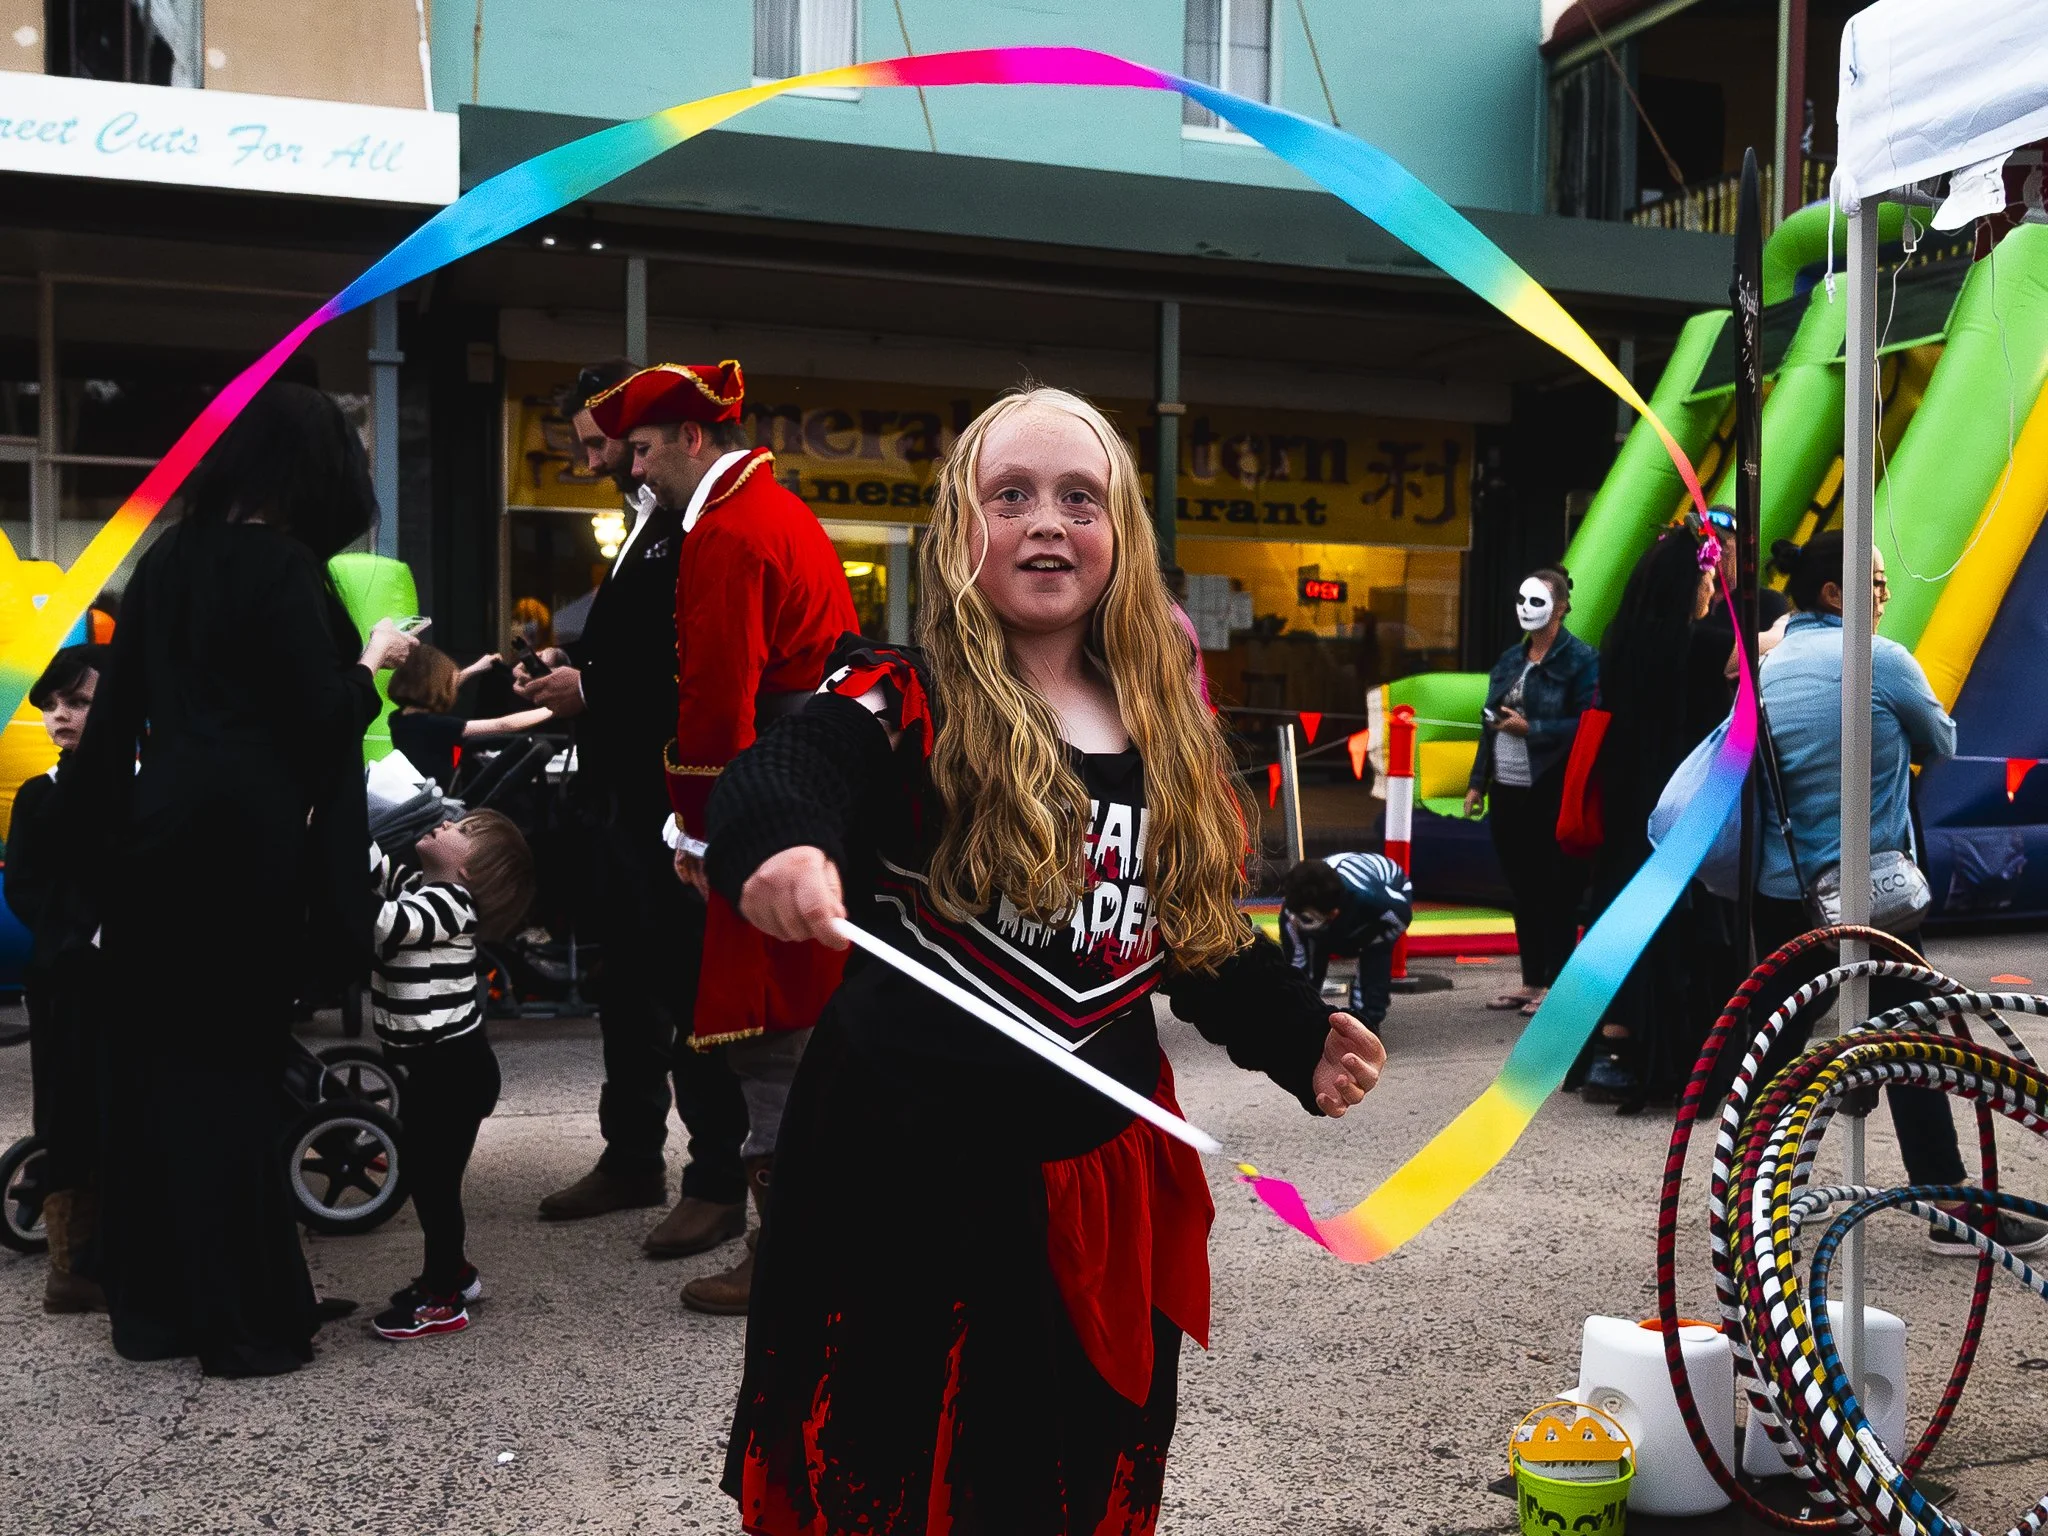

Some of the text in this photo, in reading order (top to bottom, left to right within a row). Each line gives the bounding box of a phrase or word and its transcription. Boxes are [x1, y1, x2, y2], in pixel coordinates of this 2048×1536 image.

[95, 111, 200, 156] Cuts
[227, 124, 303, 169] For
[323, 134, 406, 173] All
[1361, 439, 1460, 526] 利
